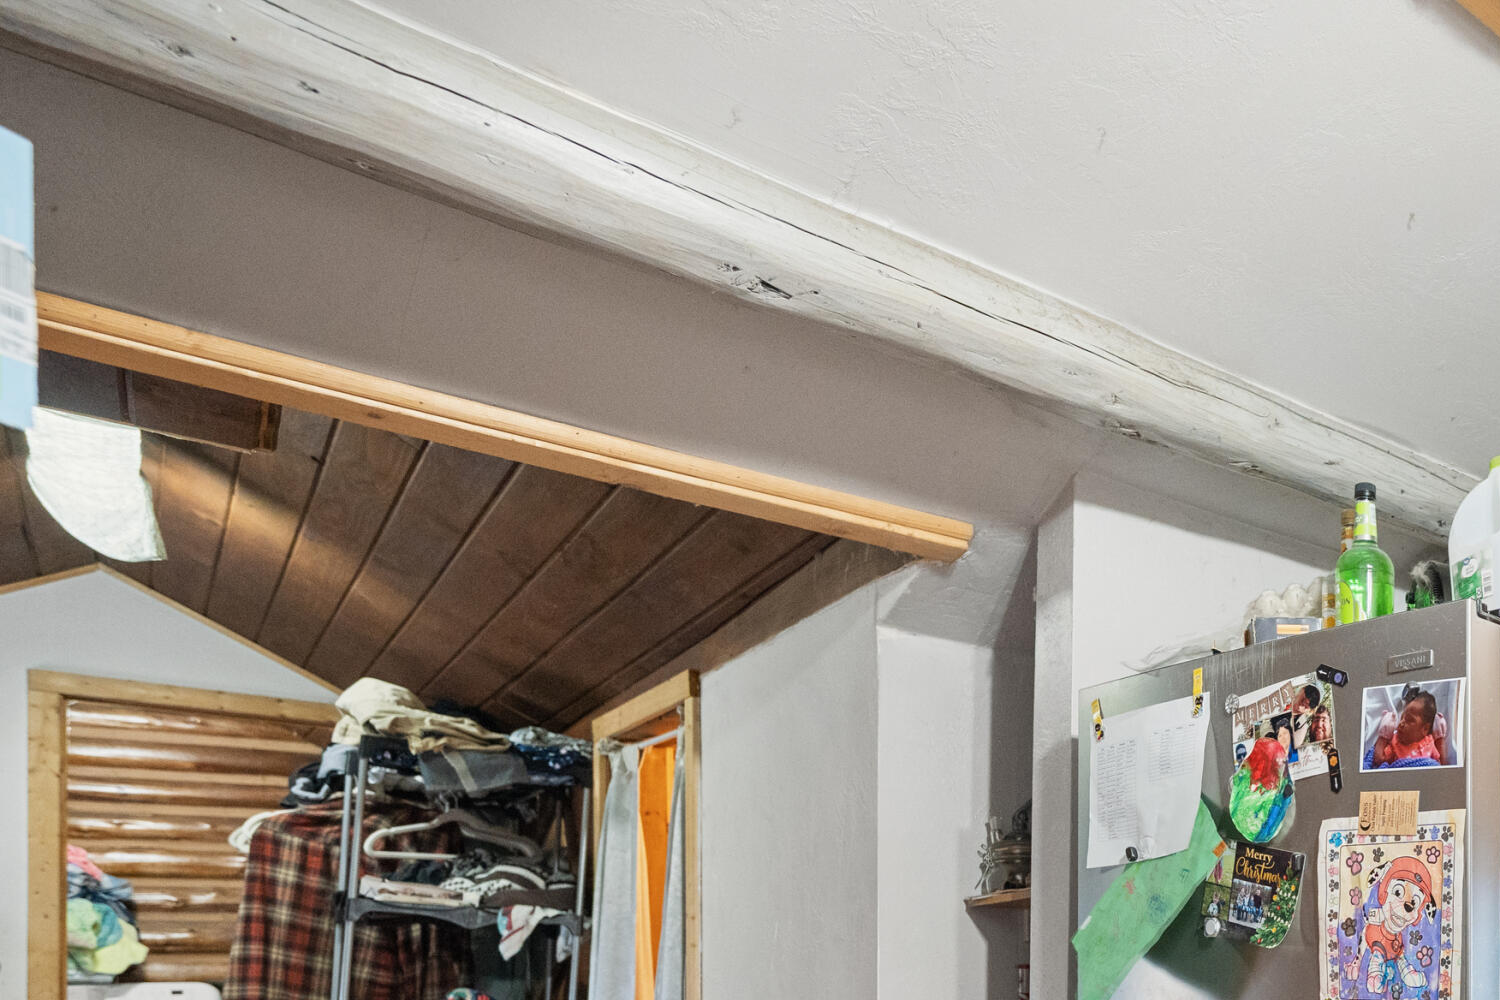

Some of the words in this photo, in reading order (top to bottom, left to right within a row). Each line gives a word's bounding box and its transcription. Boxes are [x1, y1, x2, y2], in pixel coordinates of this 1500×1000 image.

[1395, 655, 1426, 668] VISSANI
[1245, 847, 1275, 868] Merry
[1236, 857, 1281, 889] Christmas
